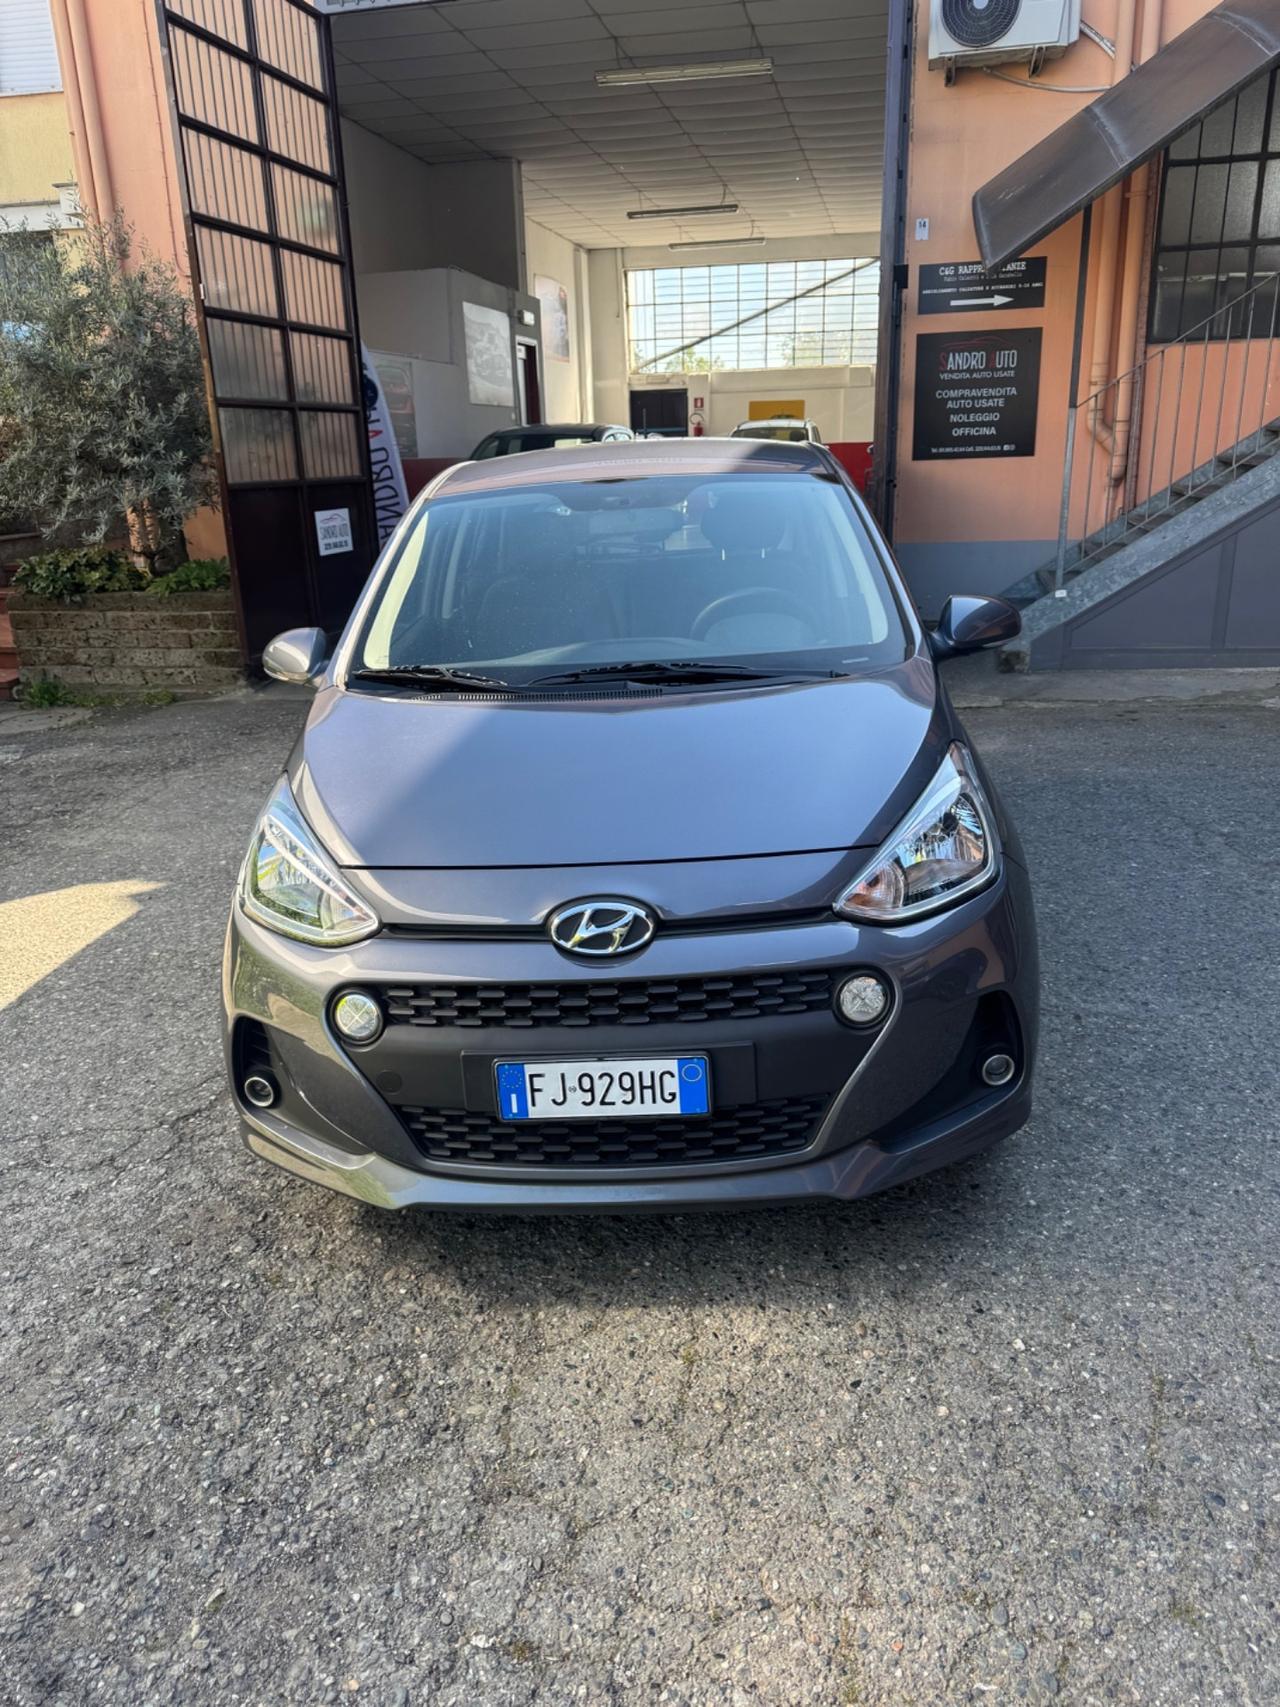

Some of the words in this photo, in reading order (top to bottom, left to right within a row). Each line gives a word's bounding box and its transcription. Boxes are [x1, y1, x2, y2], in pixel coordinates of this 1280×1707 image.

[939, 351, 986, 371] SANDRO
[990, 350, 1017, 369] AUTO
[940, 371, 970, 380] VENDITA
[972, 371, 992, 379] AUTO
[994, 370, 1015, 378] USATE
[936, 387, 1017, 399] COMPRAVENDITA
[946, 399, 972, 409] AUTO
[975, 398, 1005, 407] USATE
[950, 412, 1000, 423] NOLEGGIO
[952, 426, 996, 436] OFFICINA
